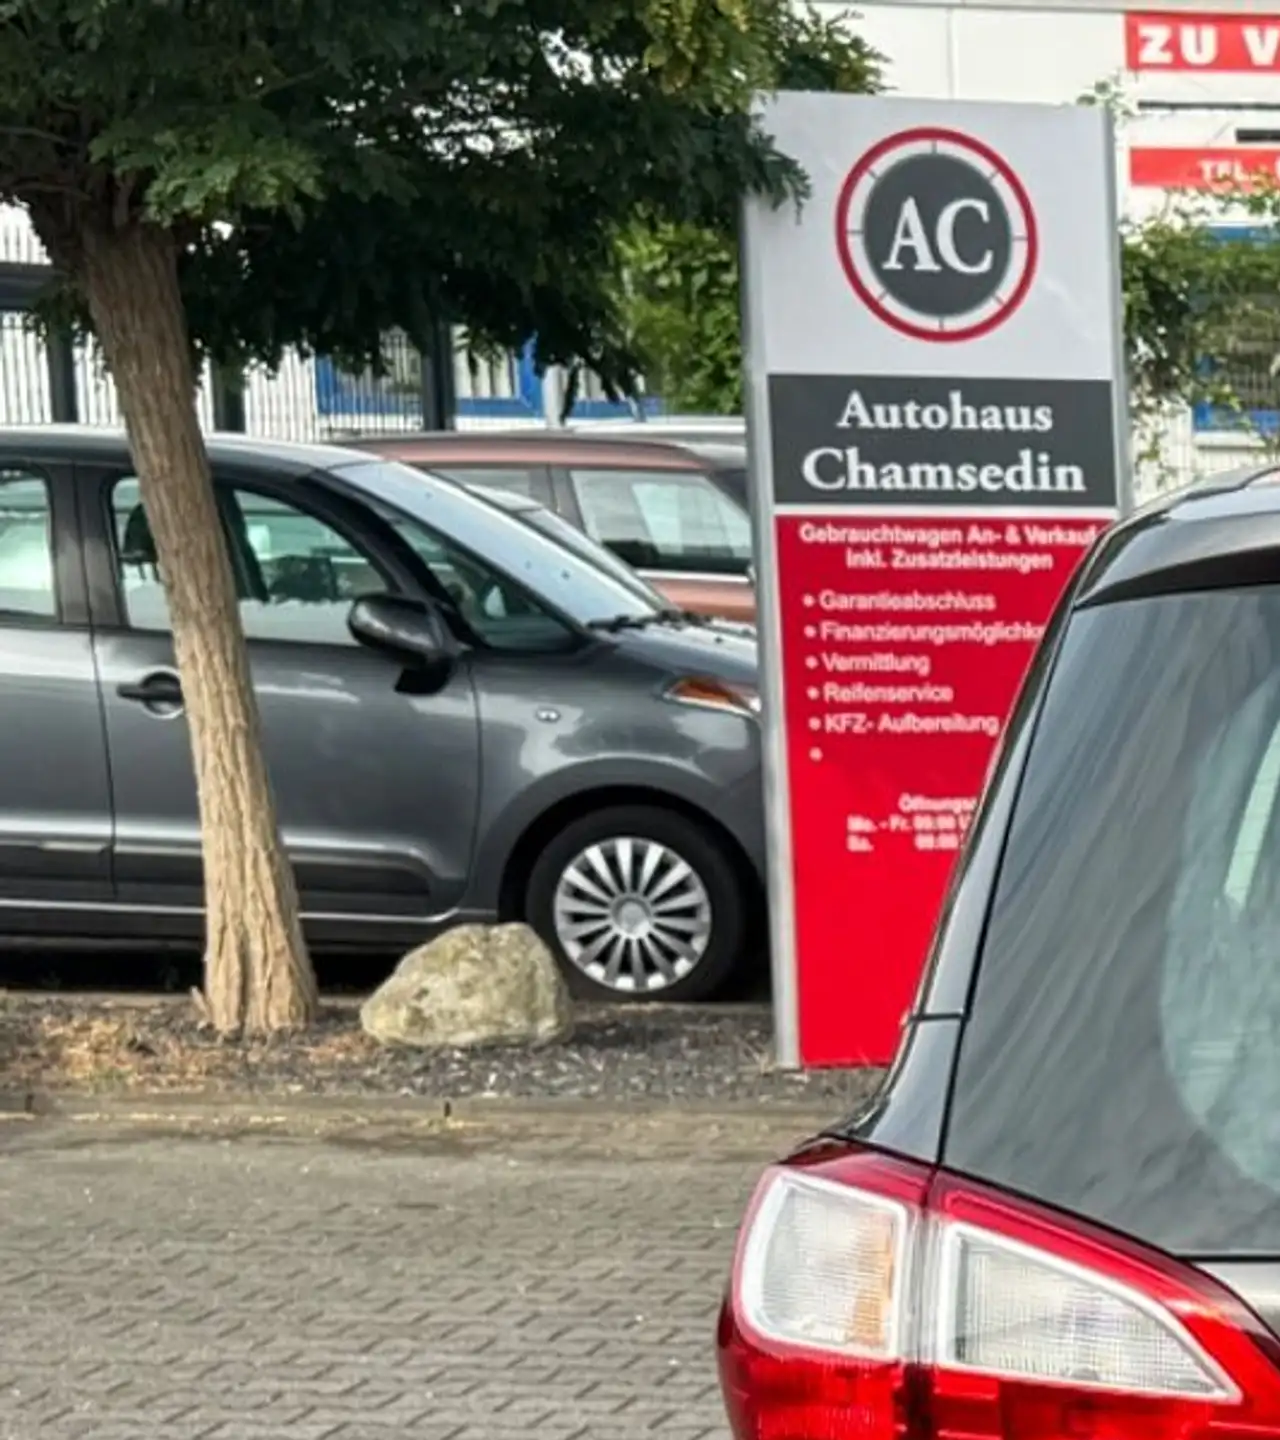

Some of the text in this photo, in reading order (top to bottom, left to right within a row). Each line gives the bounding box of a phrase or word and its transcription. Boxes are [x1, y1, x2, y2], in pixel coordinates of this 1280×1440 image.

[1137, 24, 1219, 66] ZU
[882, 197, 994, 275] AC
[836, 391, 1053, 432] Autohaus
[802, 448, 1087, 493] Chamsedin
[800, 523, 962, 548] Gebrauchtwagen
[966, 525, 1001, 544] An-
[1005, 525, 1020, 544] &
[891, 550, 1054, 574] Zusatzleistungen
[818, 590, 997, 611] Garantieabschluss
[822, 652, 931, 677] Vermittlung
[823, 682, 954, 702] Reifenservice
[824, 713, 1000, 737] KFZ- Aufbereitung
